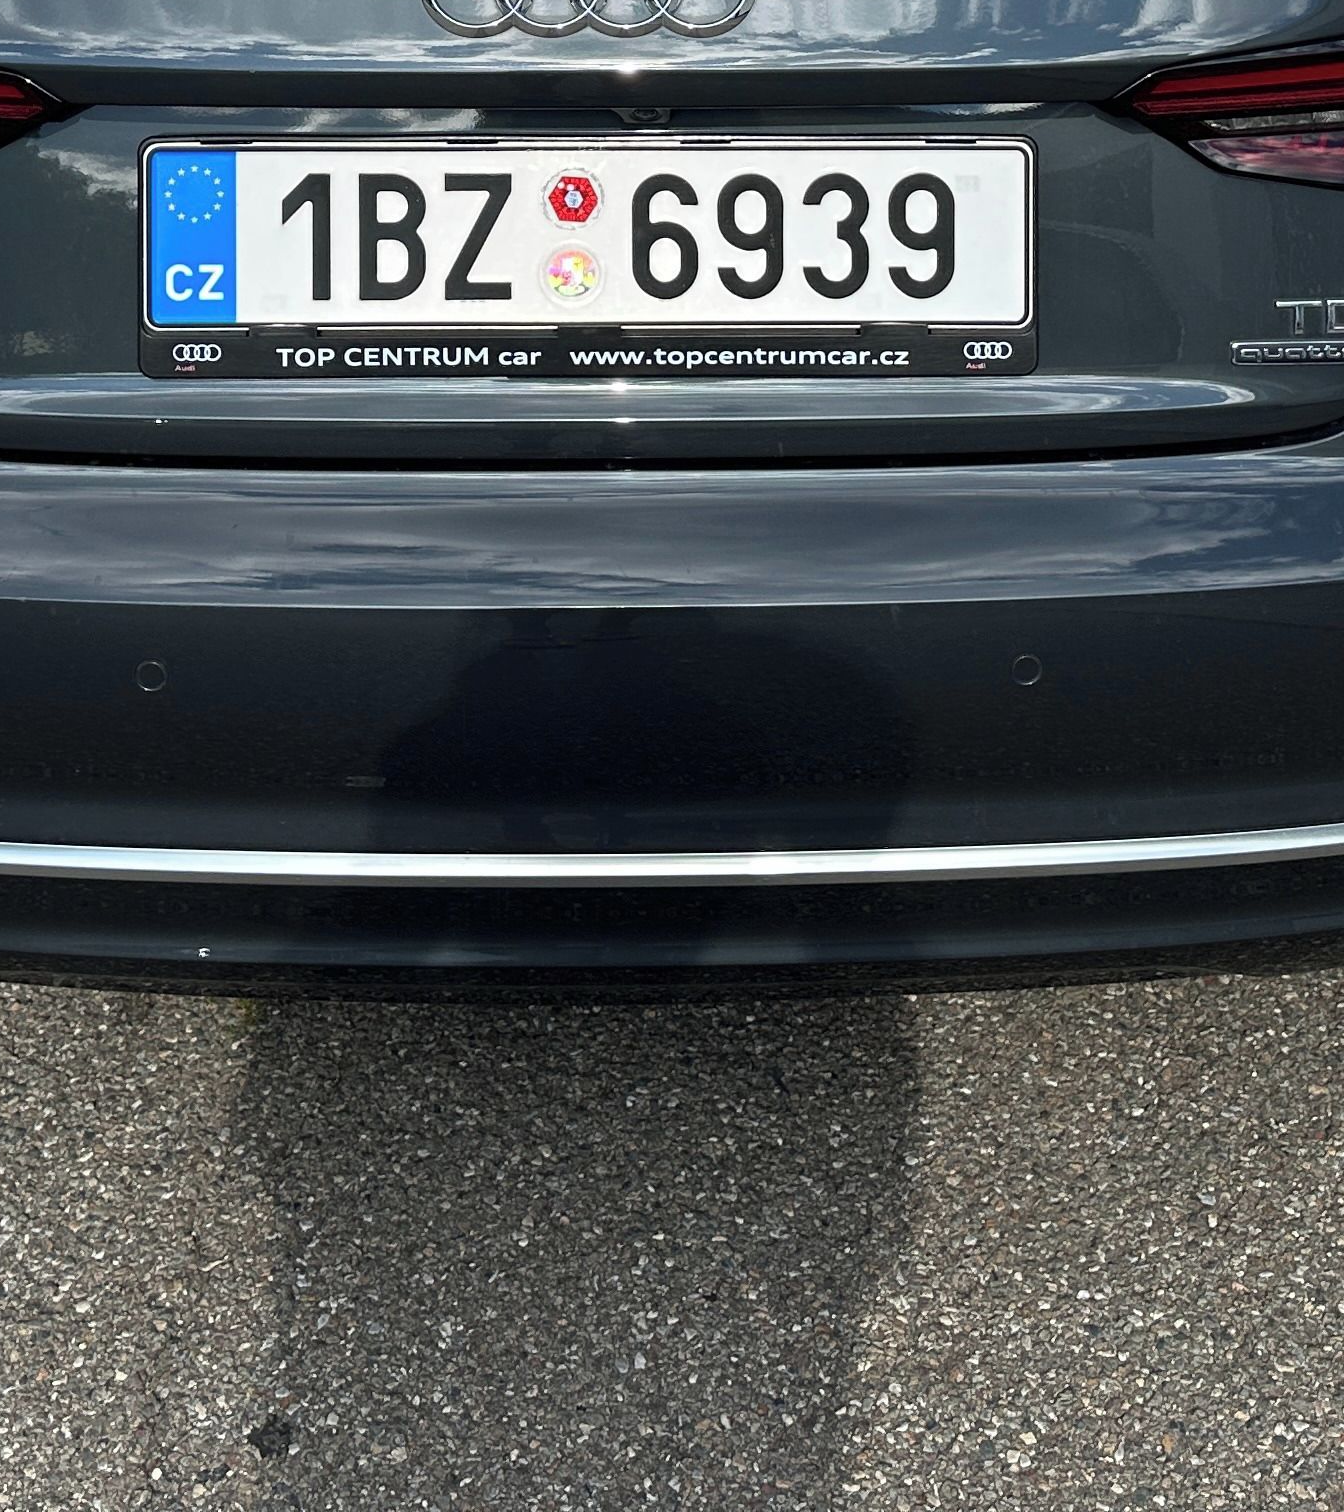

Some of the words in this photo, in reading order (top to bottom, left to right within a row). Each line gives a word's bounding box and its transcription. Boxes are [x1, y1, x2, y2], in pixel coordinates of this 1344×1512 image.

[281, 173, 512, 301] 1BZ
[631, 173, 956, 301] 6939
[165, 264, 224, 301] CZ
[174, 364, 196, 372] Audi
[276, 347, 336, 368] TOP
[343, 346, 489, 367] CENTRUM
[498, 351, 542, 366] car
[569, 347, 910, 370] www.topcentrumcar.cz
